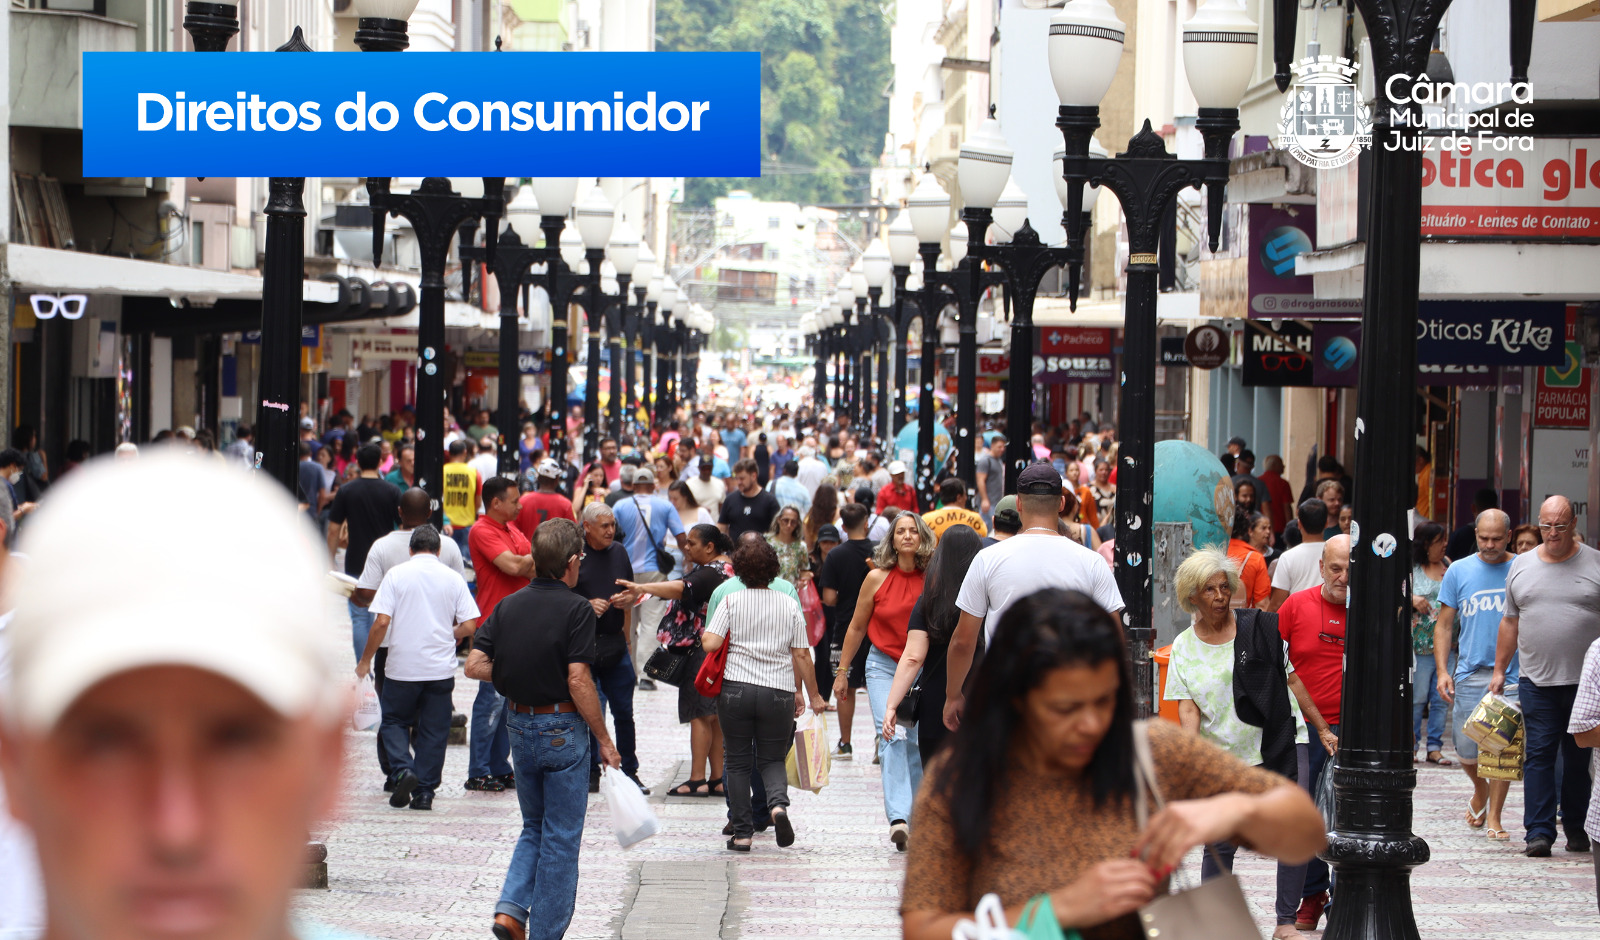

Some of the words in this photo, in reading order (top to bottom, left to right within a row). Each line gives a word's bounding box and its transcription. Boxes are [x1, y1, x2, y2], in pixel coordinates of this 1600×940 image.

[1477, 214, 1518, 228] Lentes
[1521, 214, 1538, 229] de
[1541, 215, 1590, 229] Contato
[1281, 299, 1363, 310] @drogariasouz
[1063, 334, 1104, 345] Pacheco
[1486, 319, 1553, 353] Kika
[1538, 391, 1588, 406] FARMÁCIA
[1538, 407, 1586, 420] POPULAR
[446, 473, 469, 488] COMPRO
[446, 491, 469, 507] OURO
[927, 511, 982, 531] COMPRO
